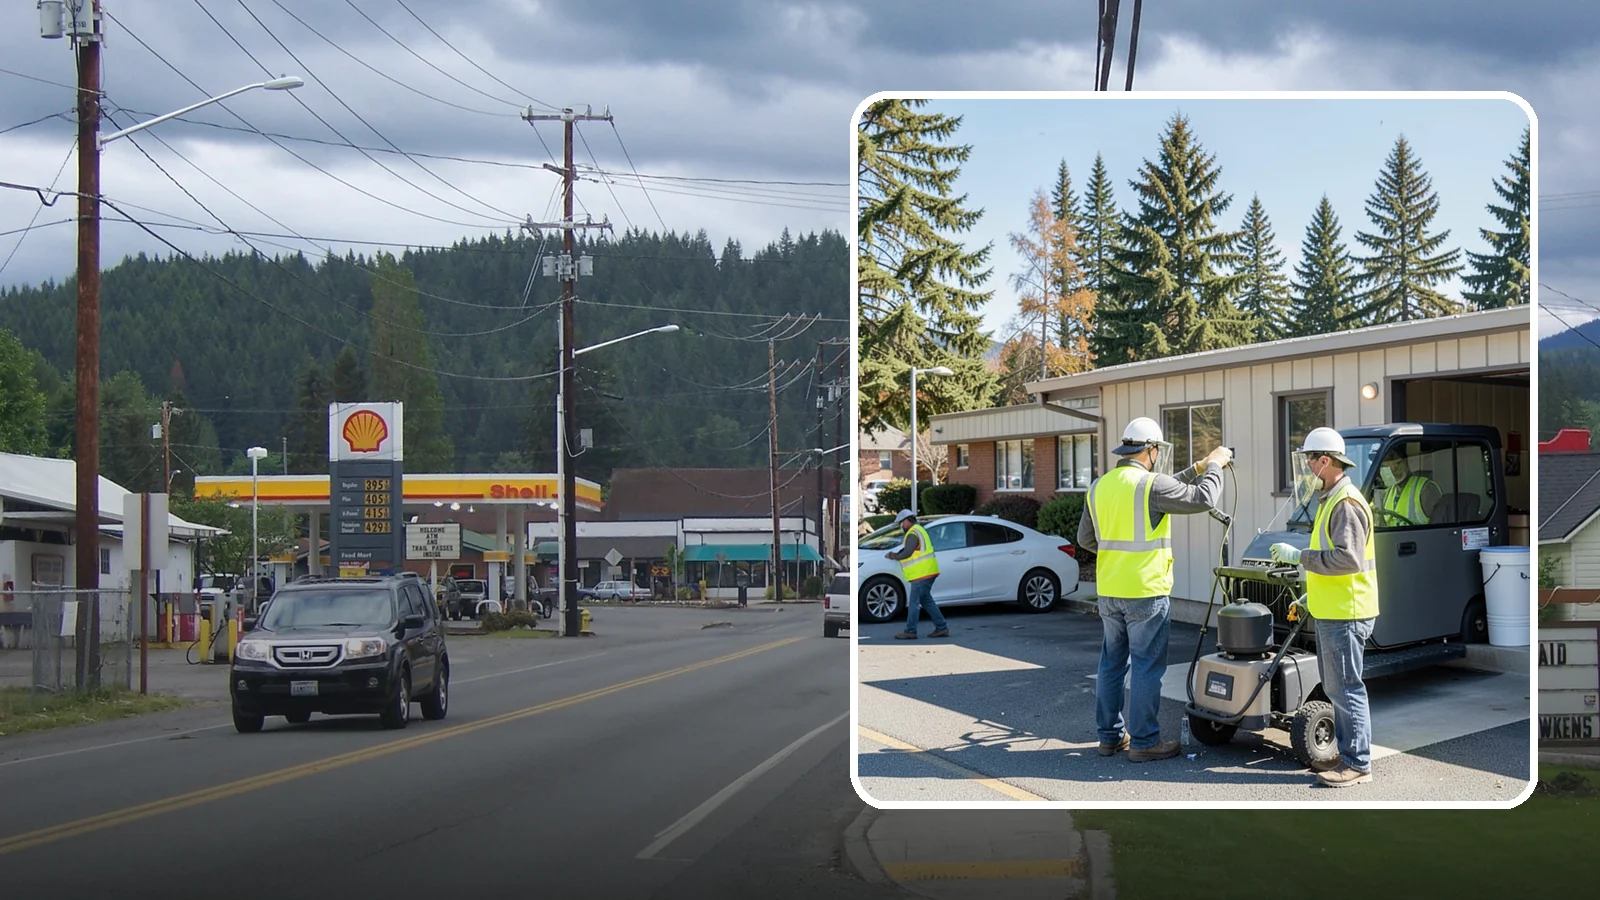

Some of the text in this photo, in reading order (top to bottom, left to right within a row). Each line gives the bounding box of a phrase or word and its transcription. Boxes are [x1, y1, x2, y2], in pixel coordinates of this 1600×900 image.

[365, 480, 384, 490] 395
[490, 484, 547, 498] Shell
[365, 494, 384, 504] 405
[365, 508, 384, 518] 415
[365, 522, 384, 532] 429
[1539, 642, 1567, 666] AID
[1538, 715, 1592, 739] WKENS
